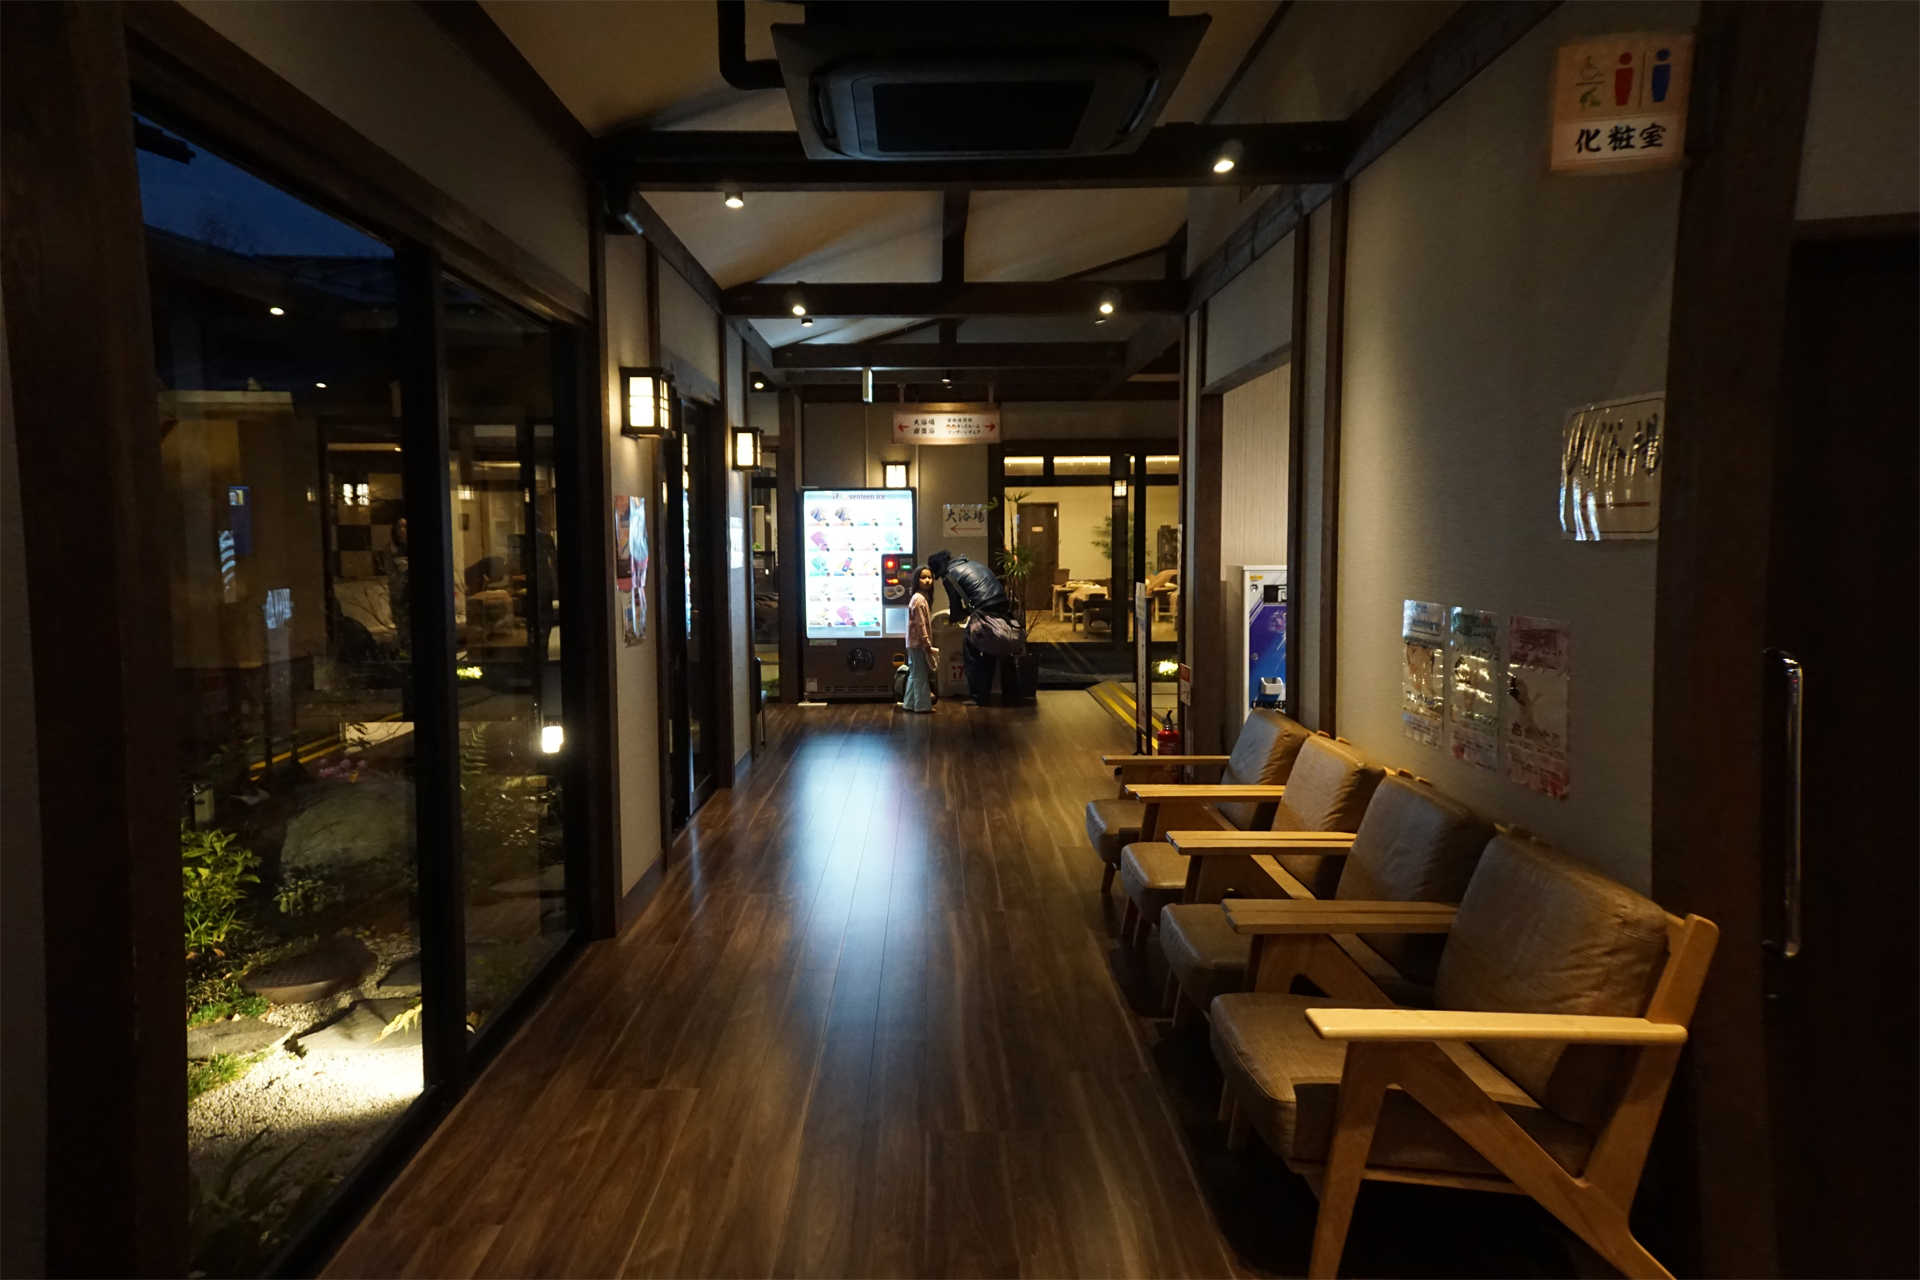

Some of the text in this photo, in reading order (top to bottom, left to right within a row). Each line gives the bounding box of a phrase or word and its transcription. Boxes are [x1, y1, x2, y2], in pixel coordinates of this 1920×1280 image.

[1575, 122, 1666, 154] 化粧室
[914, 418, 935, 426] 大浴場
[945, 508, 985, 523] 大浴場
